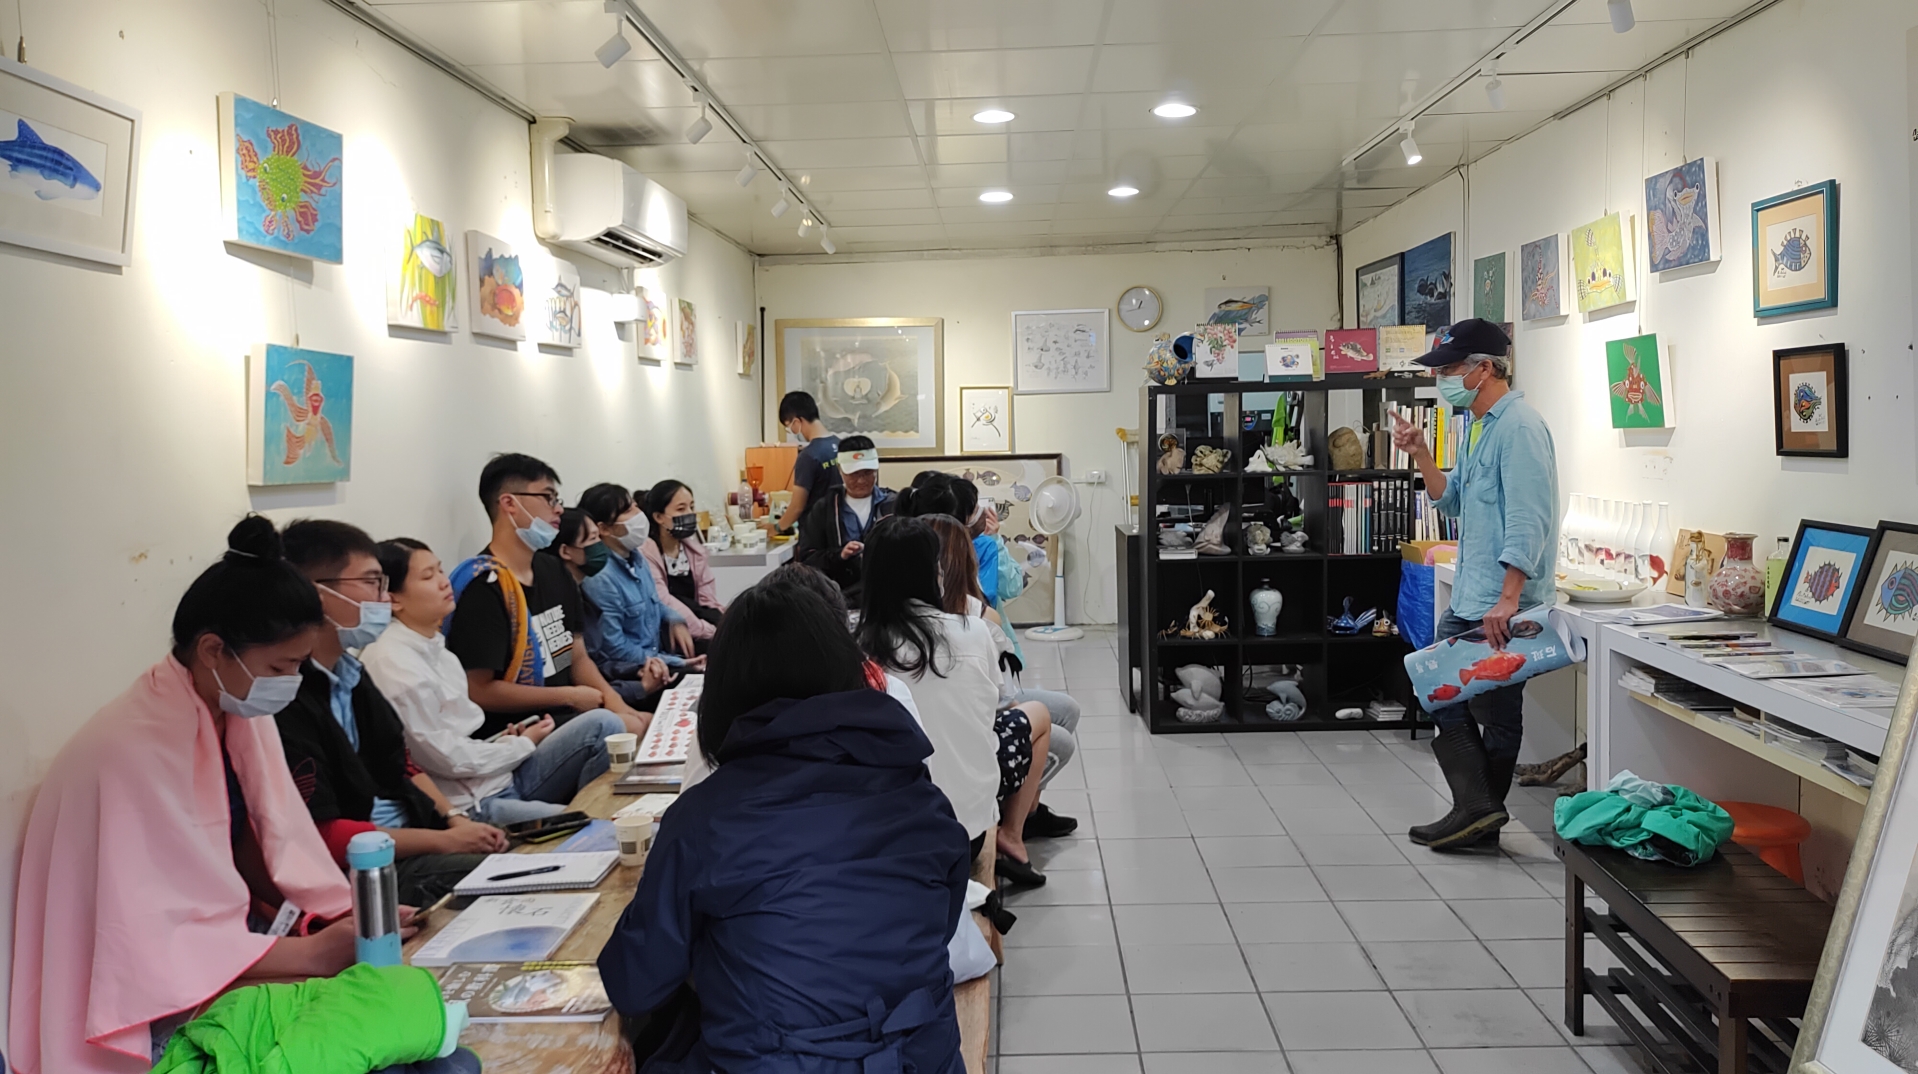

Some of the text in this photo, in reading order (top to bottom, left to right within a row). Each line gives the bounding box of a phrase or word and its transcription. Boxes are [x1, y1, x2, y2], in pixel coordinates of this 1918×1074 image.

[539, 604, 566, 626] NATURE
[543, 619, 565, 640] NEEDS
[547, 630, 574, 653] HEROES
[1530, 644, 1557, 662] 石斑
